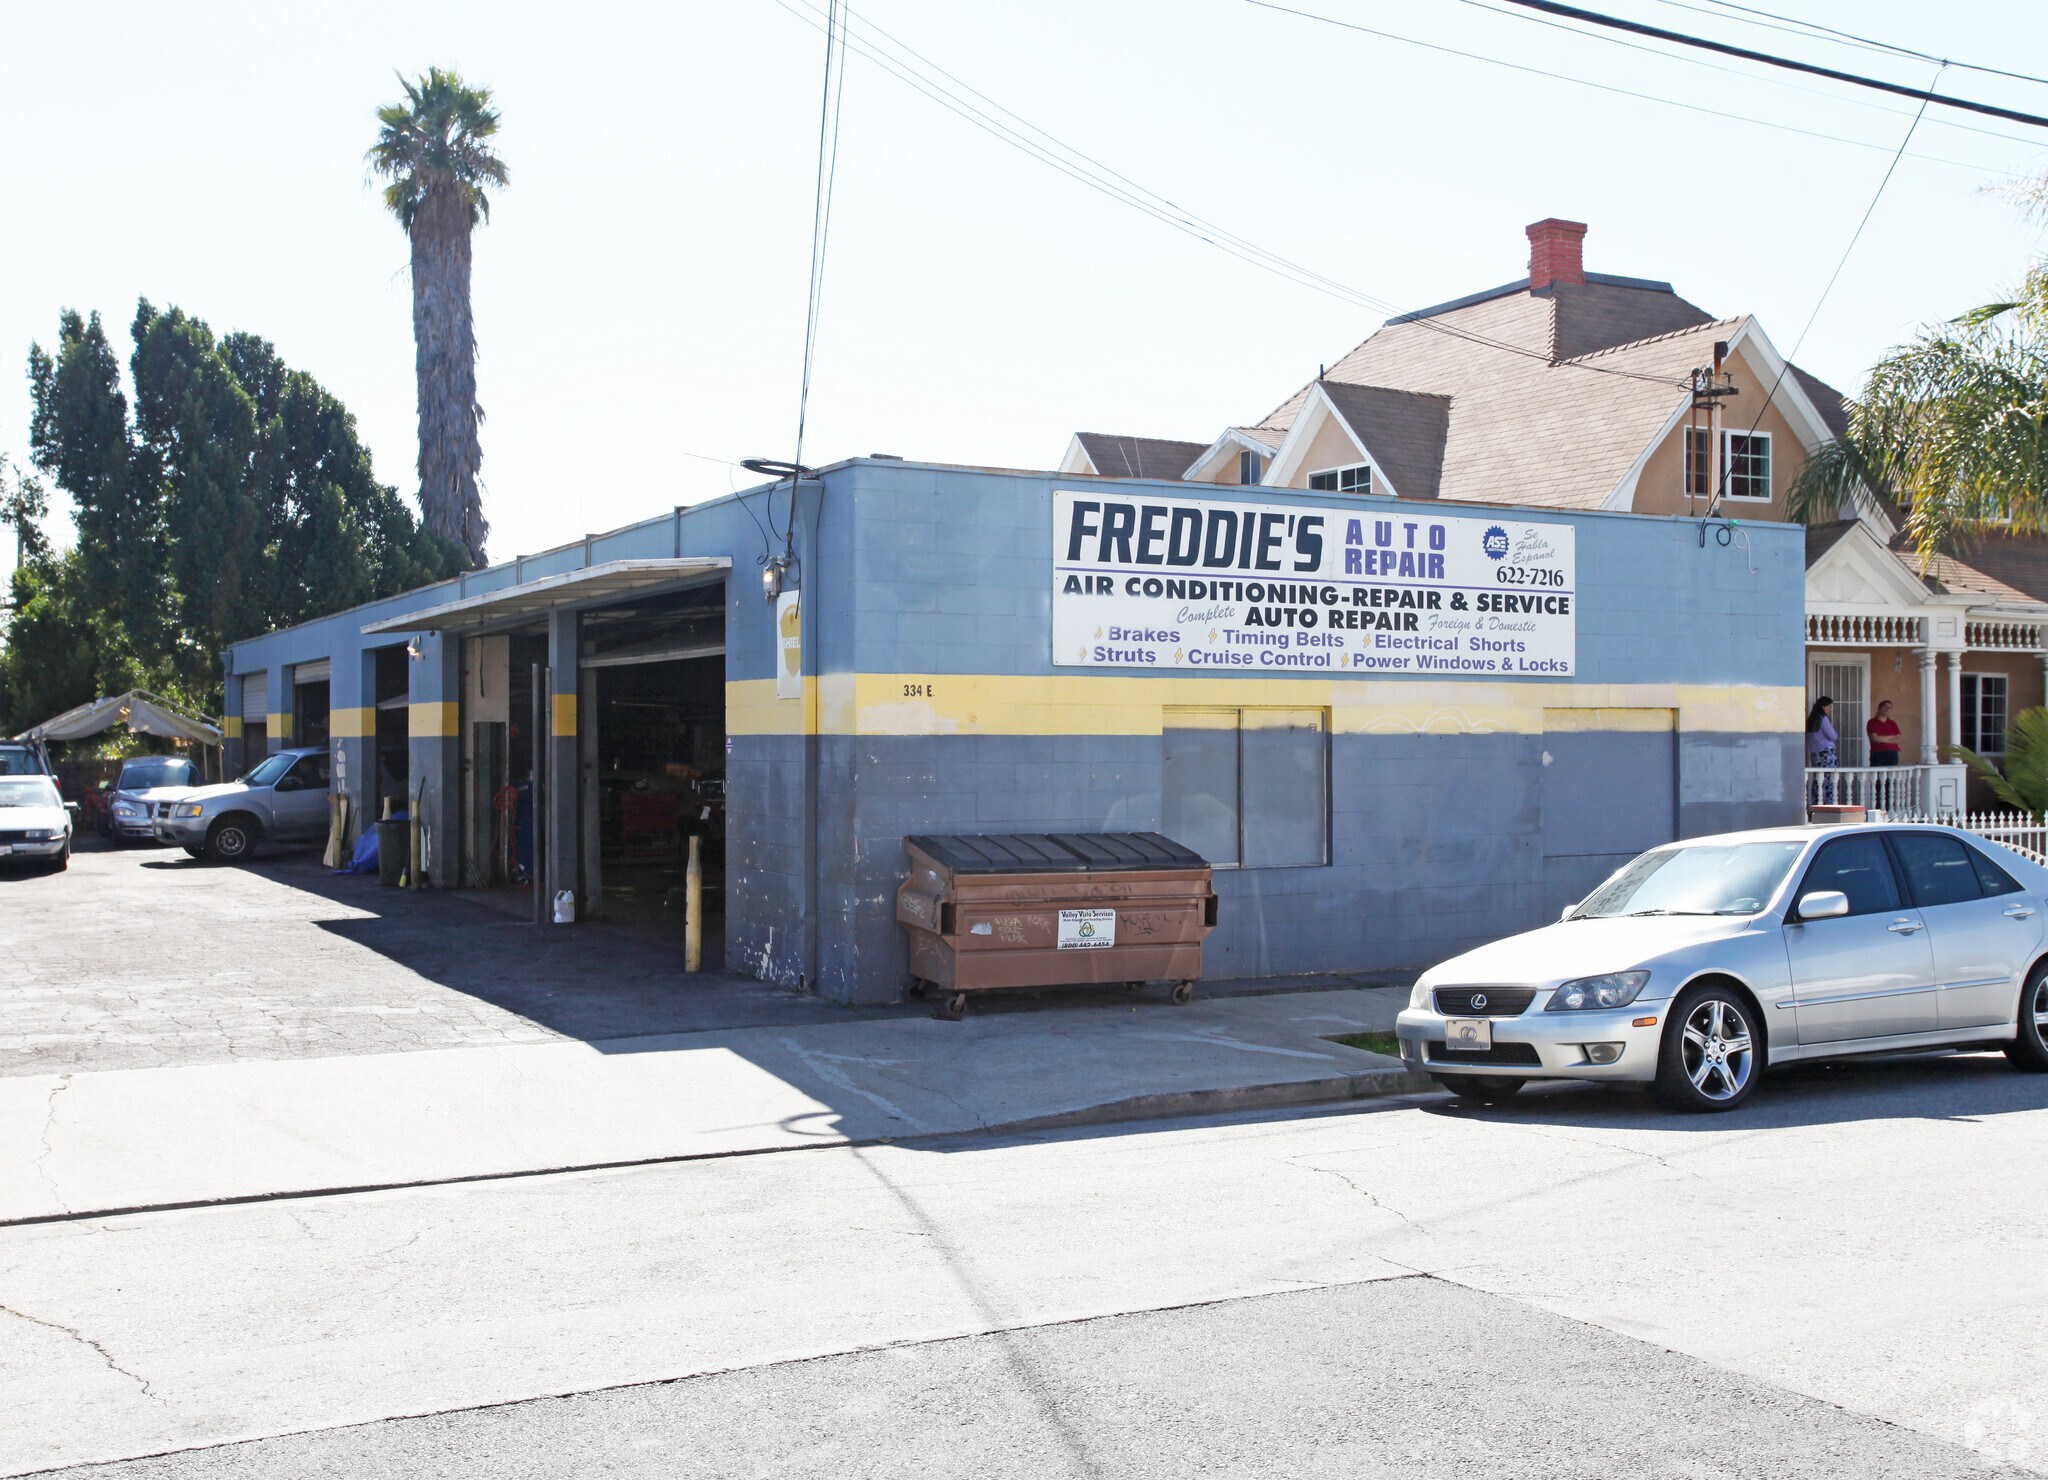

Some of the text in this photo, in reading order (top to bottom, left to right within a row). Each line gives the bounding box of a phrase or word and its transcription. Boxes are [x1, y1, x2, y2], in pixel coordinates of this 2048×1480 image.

[1066, 500, 1325, 573] FREDDIE'S
[1345, 518, 1446, 551] AUTO
[1486, 536, 1506, 548] ASE
[1523, 528, 1538, 540] Se
[1515, 538, 1549, 552] Habla
[1344, 548, 1445, 579] REPAIR
[1511, 548, 1556, 565] Espanol
[1496, 565, 1564, 587] 622-7216
[1062, 575, 1115, 597] AIR
[1450, 591, 1469, 612] &
[1476, 593, 1570, 615] SERVICE
[1176, 604, 1236, 625] Complete
[1244, 606, 1419, 632] AUTO REPAIR
[1428, 613, 1537, 634] Foreign & Domestic
[783, 636, 801, 649] SHIEL
[1108, 626, 1181, 643] Brakes
[1222, 629, 1345, 650] Timing Belts
[1375, 634, 1526, 653] Electrical Shorts
[1093, 646, 1157, 663] Struts
[1188, 648, 1331, 667] Cruise Control
[1353, 653, 1569, 673] Power Windows & Locks
[903, 684, 923, 698] 334
[1061, 911, 1078, 919] Valley
[1078, 910, 1092, 918] Vista
